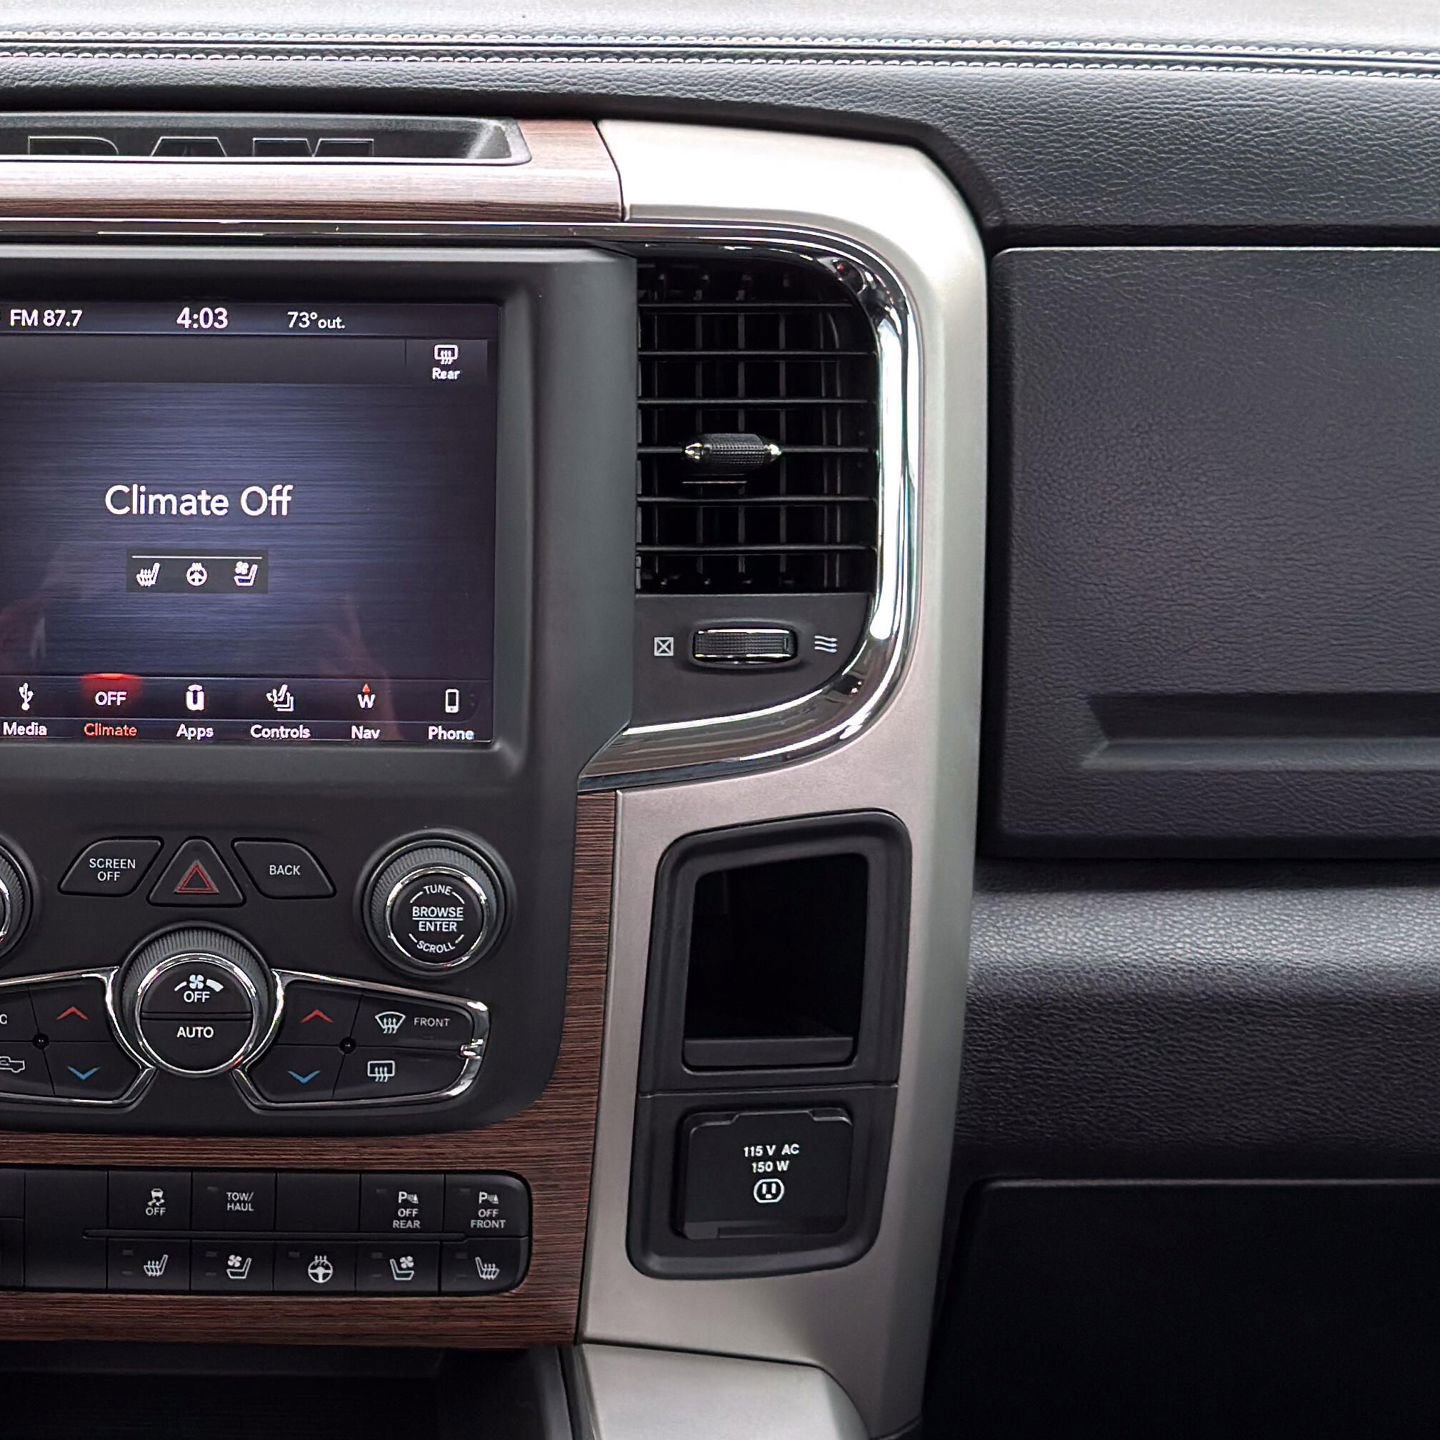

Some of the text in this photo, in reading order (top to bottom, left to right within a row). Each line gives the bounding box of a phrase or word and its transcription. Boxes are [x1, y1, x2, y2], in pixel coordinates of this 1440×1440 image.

[10, 310, 83, 327] FM 87.7
[176, 307, 228, 330] 4:03
[431, 367, 460, 381] Rear
[104, 484, 293, 518] Climate Off
[95, 690, 126, 707] OFF
[2, 722, 47, 737] Media
[84, 722, 137, 738] Climate
[176, 724, 214, 741] Apps
[250, 724, 310, 740] Controls
[350, 725, 380, 740] Nav
[428, 726, 474, 741] Phone
[88, 858, 136, 872] SCREEN
[269, 864, 301, 877] BACK
[97, 870, 121, 883] OFF
[424, 884, 452, 897] TUNE
[412, 905, 464, 919] BROWSE
[417, 920, 458, 933] ENTER
[417, 939, 456, 955] SCROLL
[183, 990, 210, 1004] OFF
[413, 1015, 450, 1029] FRONT
[176, 1025, 214, 1040] AUTO
[743, 1145, 763, 1158] 115
[781, 1143, 800, 1156] AC
[751, 1160, 790, 1174] 150 W
[226, 1191, 254, 1205] TOW/
[145, 1206, 166, 1218] OFF
[226, 1202, 254, 1213] HAUL
[397, 1207, 419, 1219] OFF
[477, 1207, 499, 1219] OFF
[392, 1218, 421, 1230] REAR
[469, 1218, 507, 1230] FRONT
